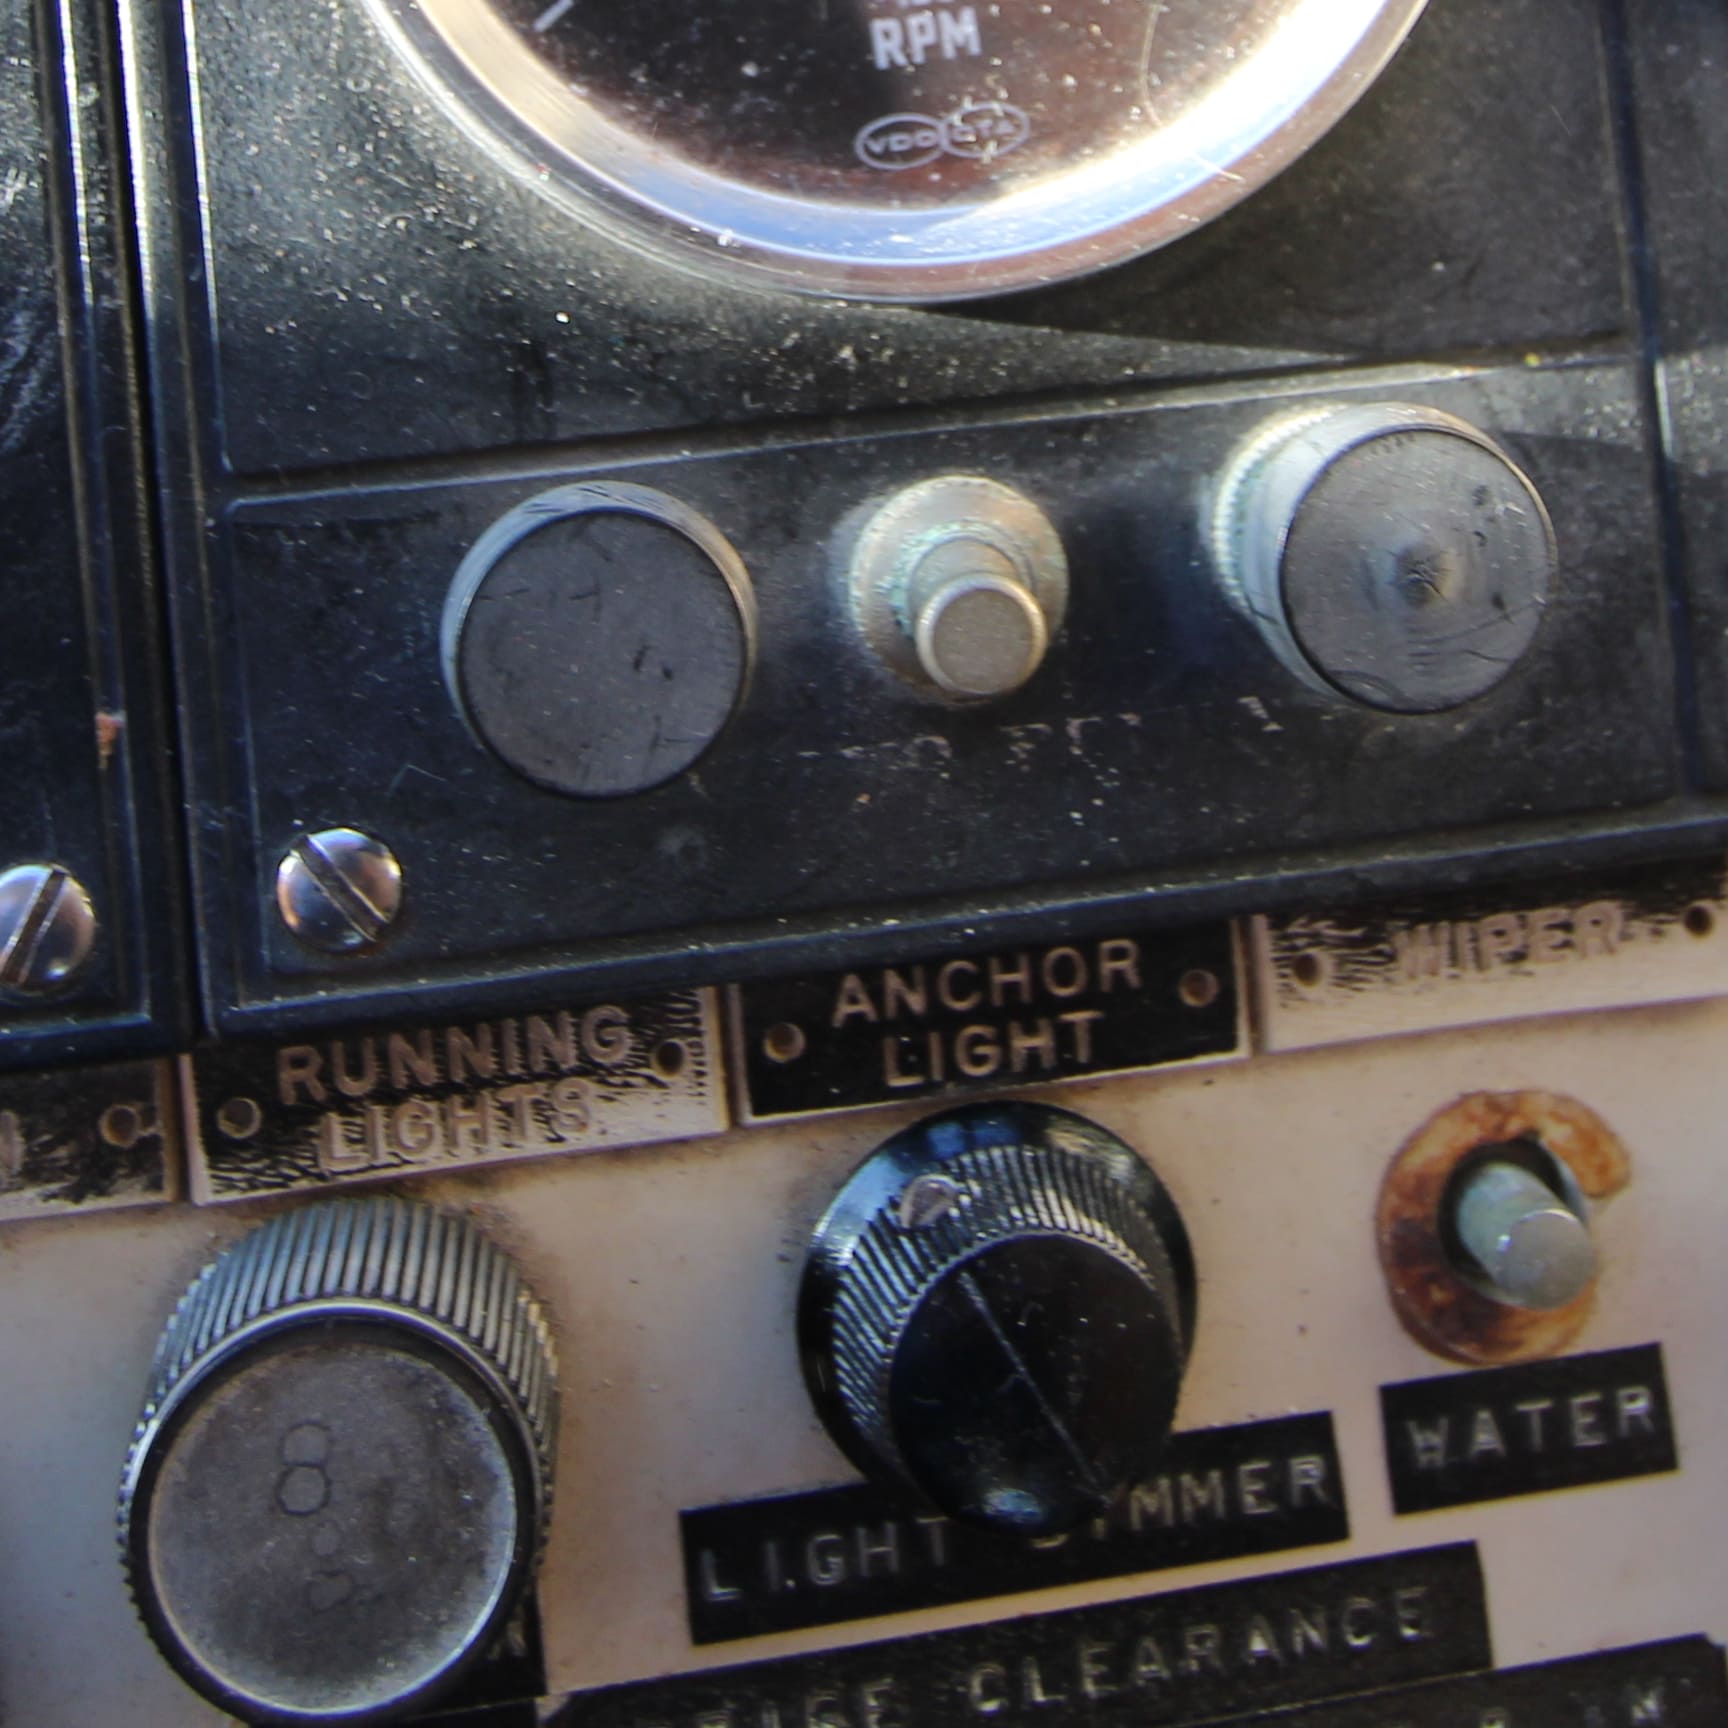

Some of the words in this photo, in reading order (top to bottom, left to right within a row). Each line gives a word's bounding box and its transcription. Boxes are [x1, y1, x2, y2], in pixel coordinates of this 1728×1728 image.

[869, 6, 982, 71] RPM
[832, 938, 1142, 1029] ANCHOR
[1392, 899, 1624, 978] WIPER
[276, 1003, 635, 1106] RUNNING
[883, 1010, 1104, 1087] LIGHT
[318, 1076, 592, 1174] LIGHTS
[1407, 1385, 1657, 1471] WATER
[699, 1514, 951, 1602] LIGHT
[1032, 1454, 1330, 1551] MMER
[964, 1585, 1434, 1715] CLEARANCE
